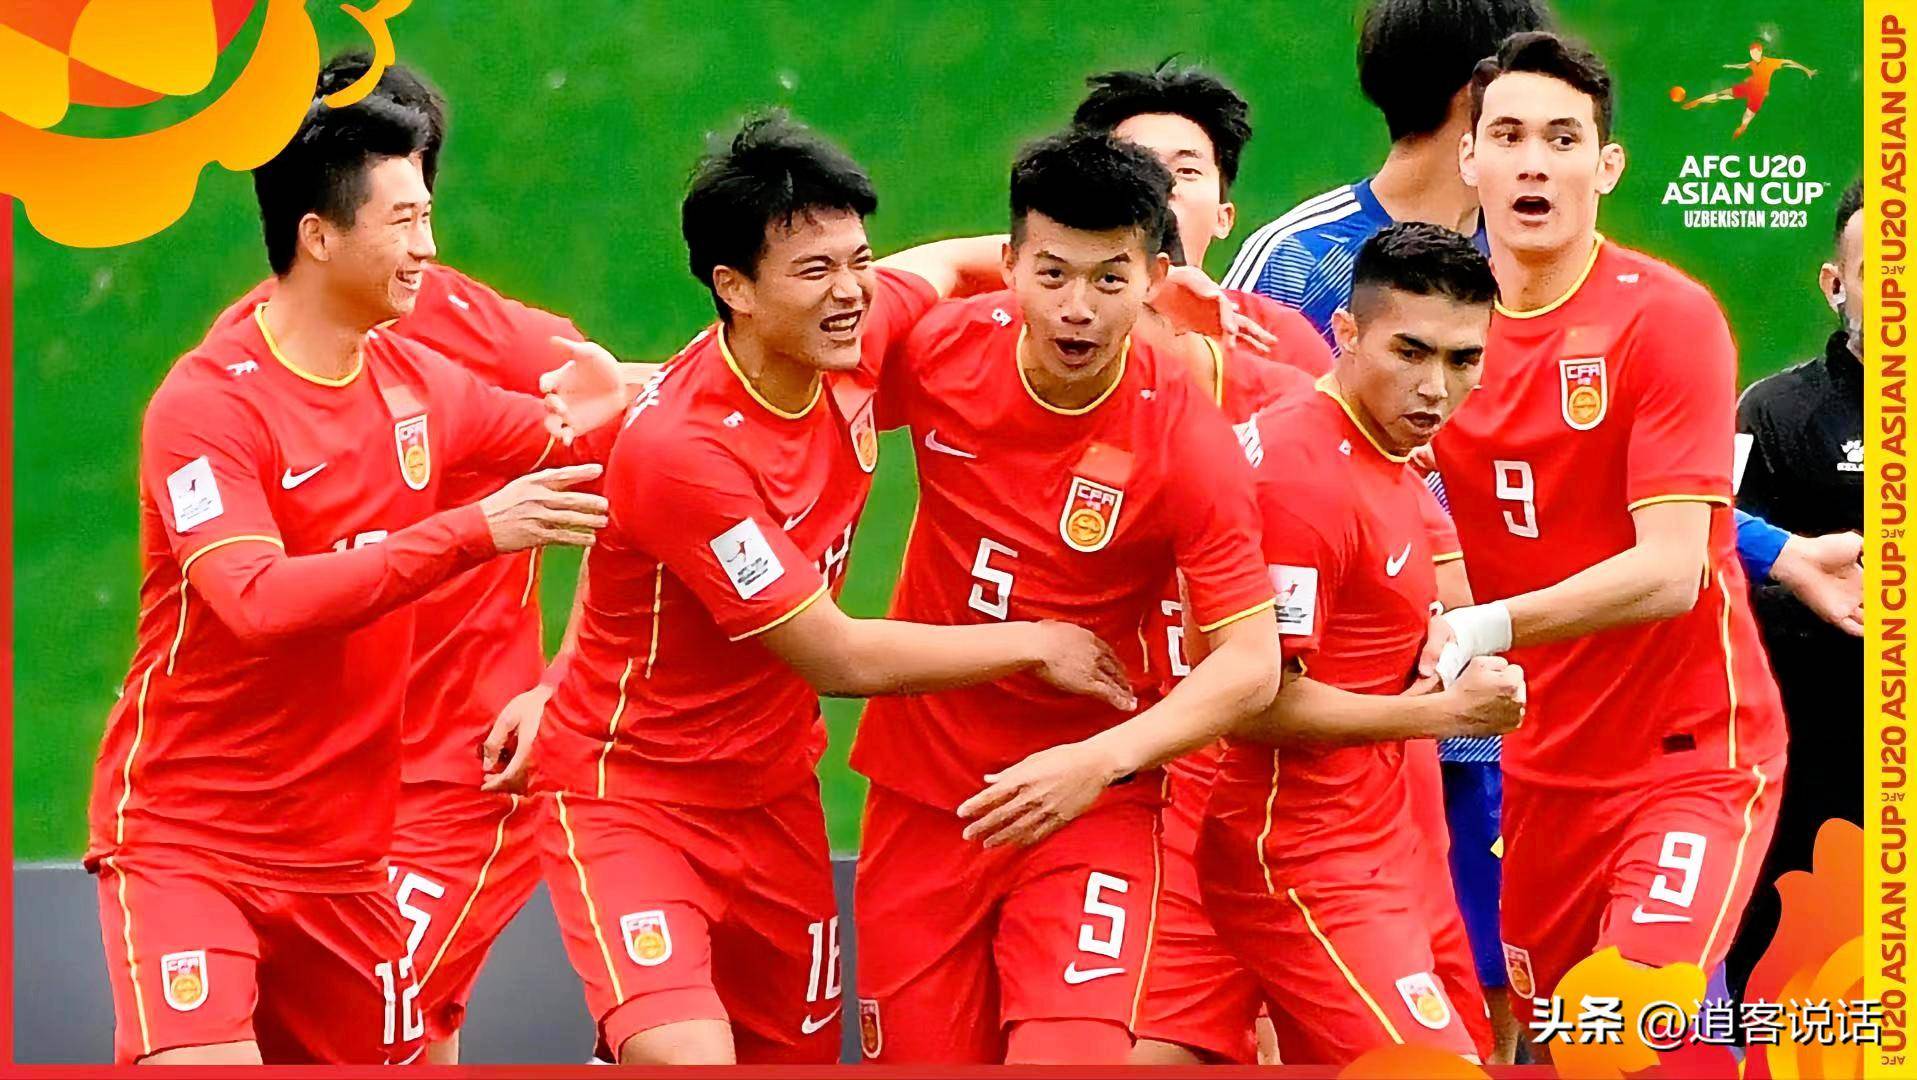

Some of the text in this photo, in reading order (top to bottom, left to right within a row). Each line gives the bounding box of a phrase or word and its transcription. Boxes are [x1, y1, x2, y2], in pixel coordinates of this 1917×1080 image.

[1493, 460, 1540, 538] 9
[968, 537, 1018, 620] 5
[1649, 832, 1707, 907] 9
[1078, 871, 1129, 959] 5
